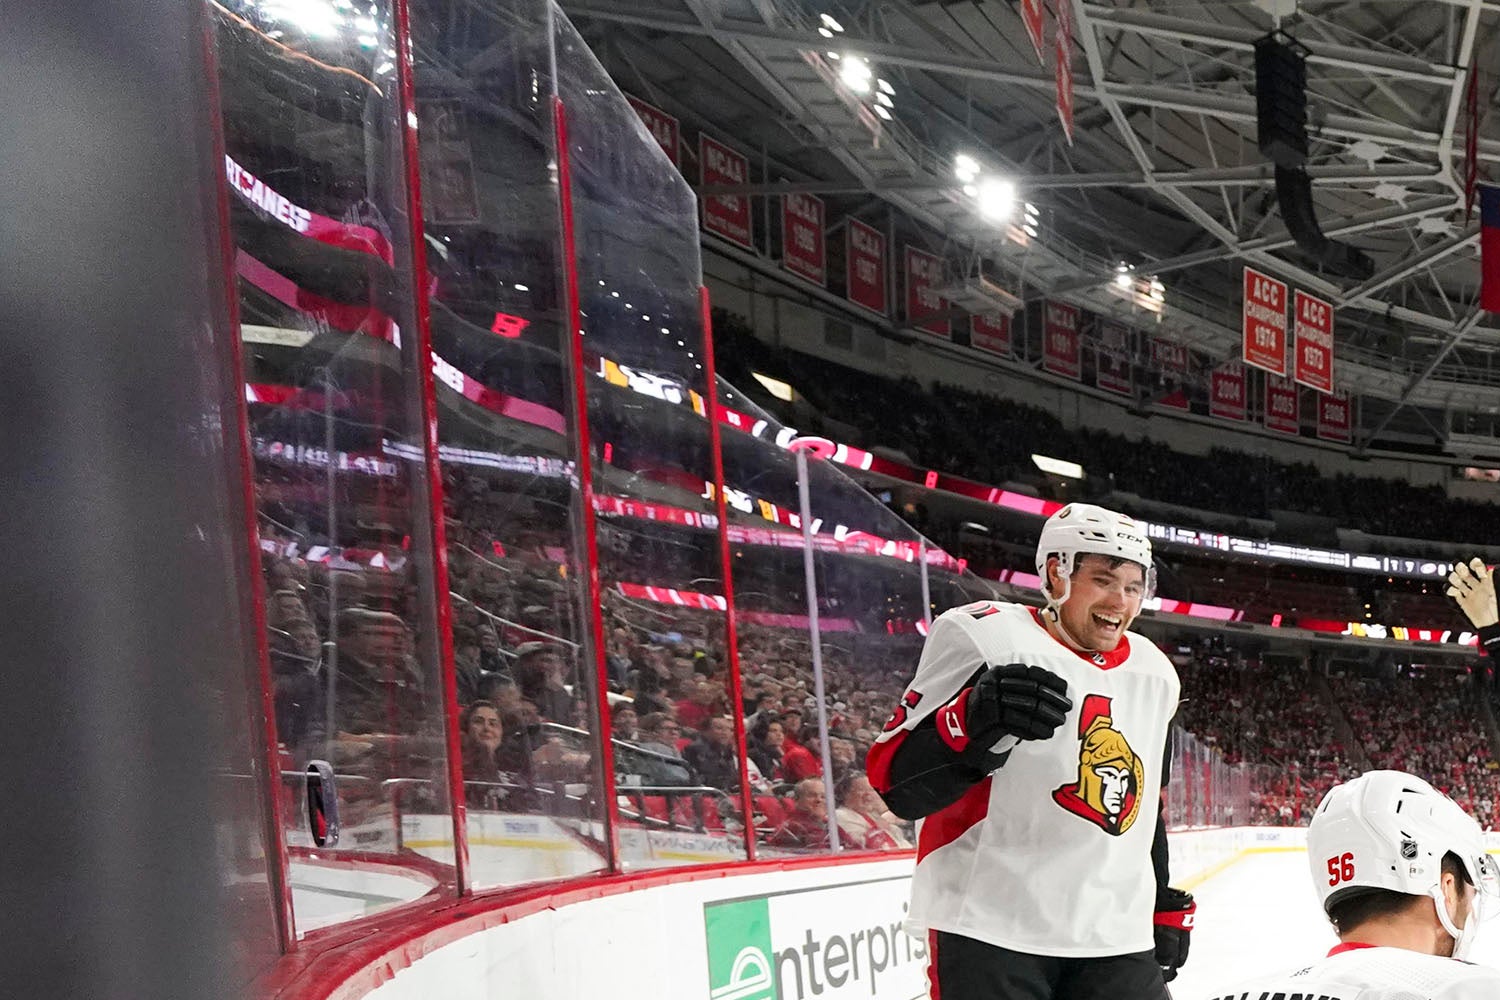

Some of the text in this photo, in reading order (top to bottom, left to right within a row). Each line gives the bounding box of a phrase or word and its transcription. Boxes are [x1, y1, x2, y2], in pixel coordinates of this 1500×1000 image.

[1254, 276, 1279, 306] ACC
[1246, 301, 1286, 329] CHAMPIONS
[1303, 299, 1325, 327] ACC
[1255, 325, 1276, 349] 1974
[1297, 320, 1332, 349] CHAMPIONS
[1117, 532, 1143, 544] CCM
[1327, 851, 1355, 887] 56
